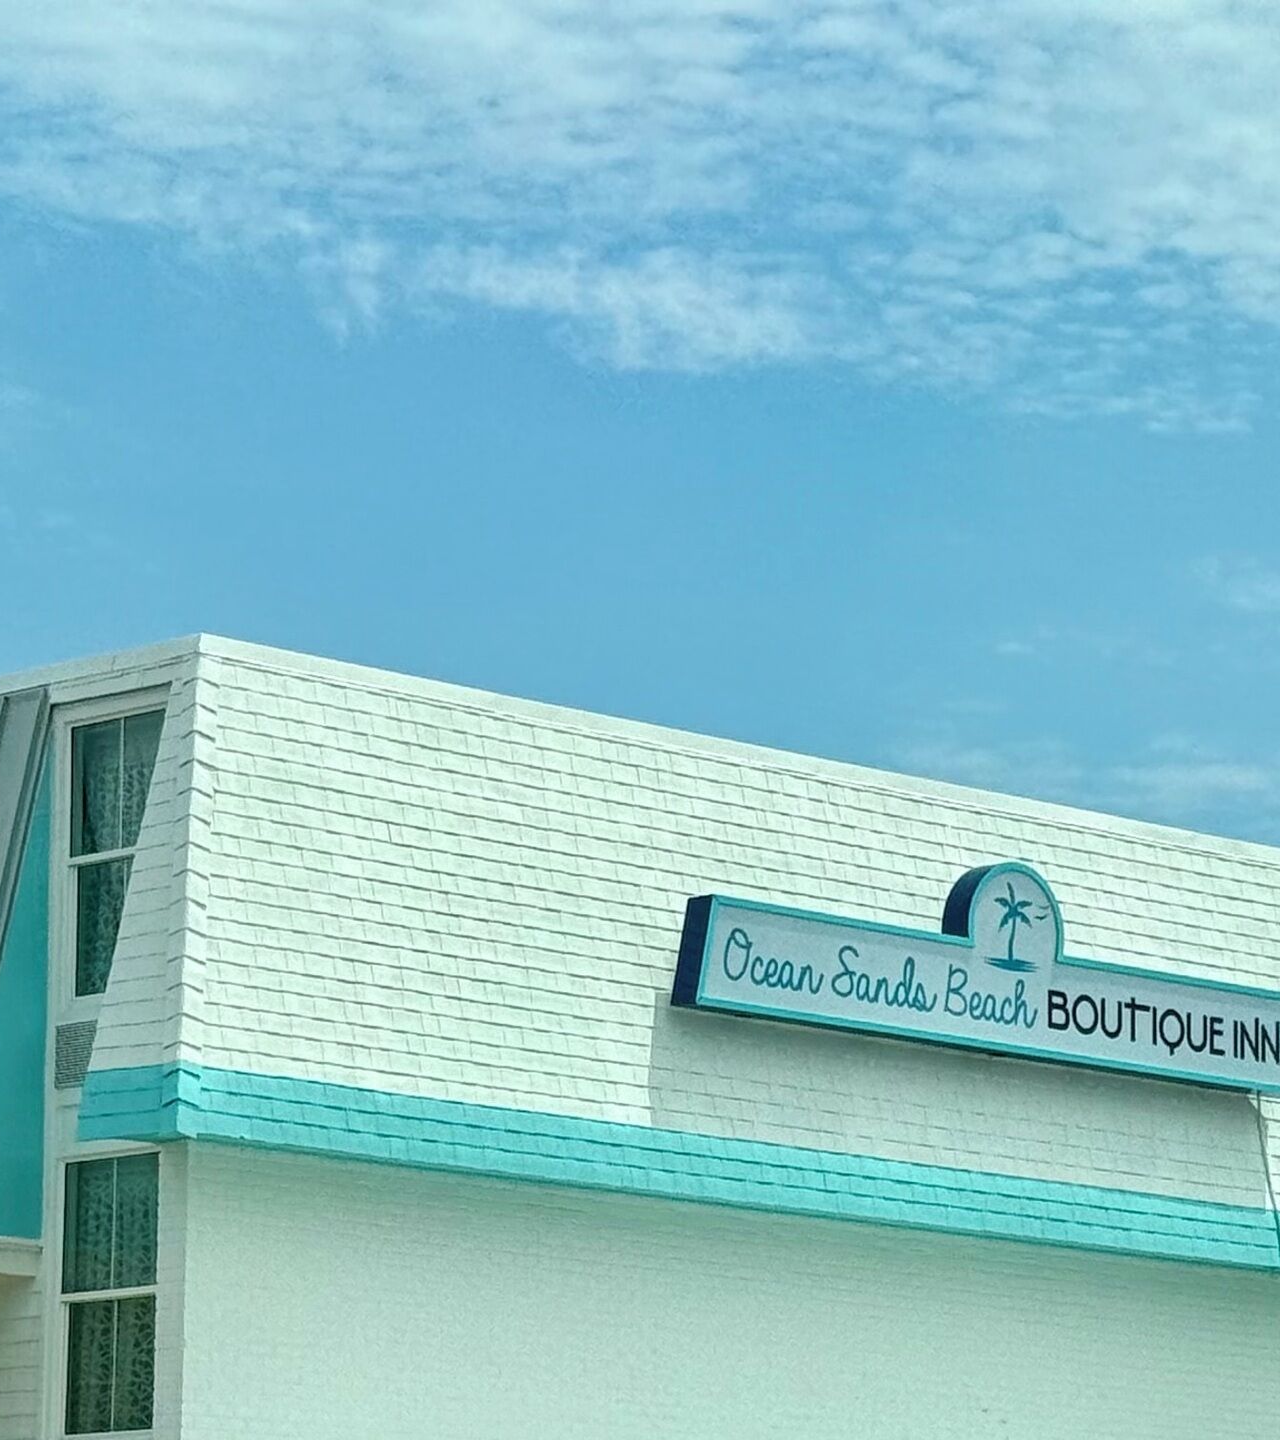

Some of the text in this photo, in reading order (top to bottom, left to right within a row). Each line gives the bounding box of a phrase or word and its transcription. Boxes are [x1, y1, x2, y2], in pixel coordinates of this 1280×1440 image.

[723, 927, 825, 996] Ocean
[831, 945, 939, 1013] Sands
[943, 962, 1038, 1029] Beach
[1046, 988, 1226, 1057] BOUTIQUE
